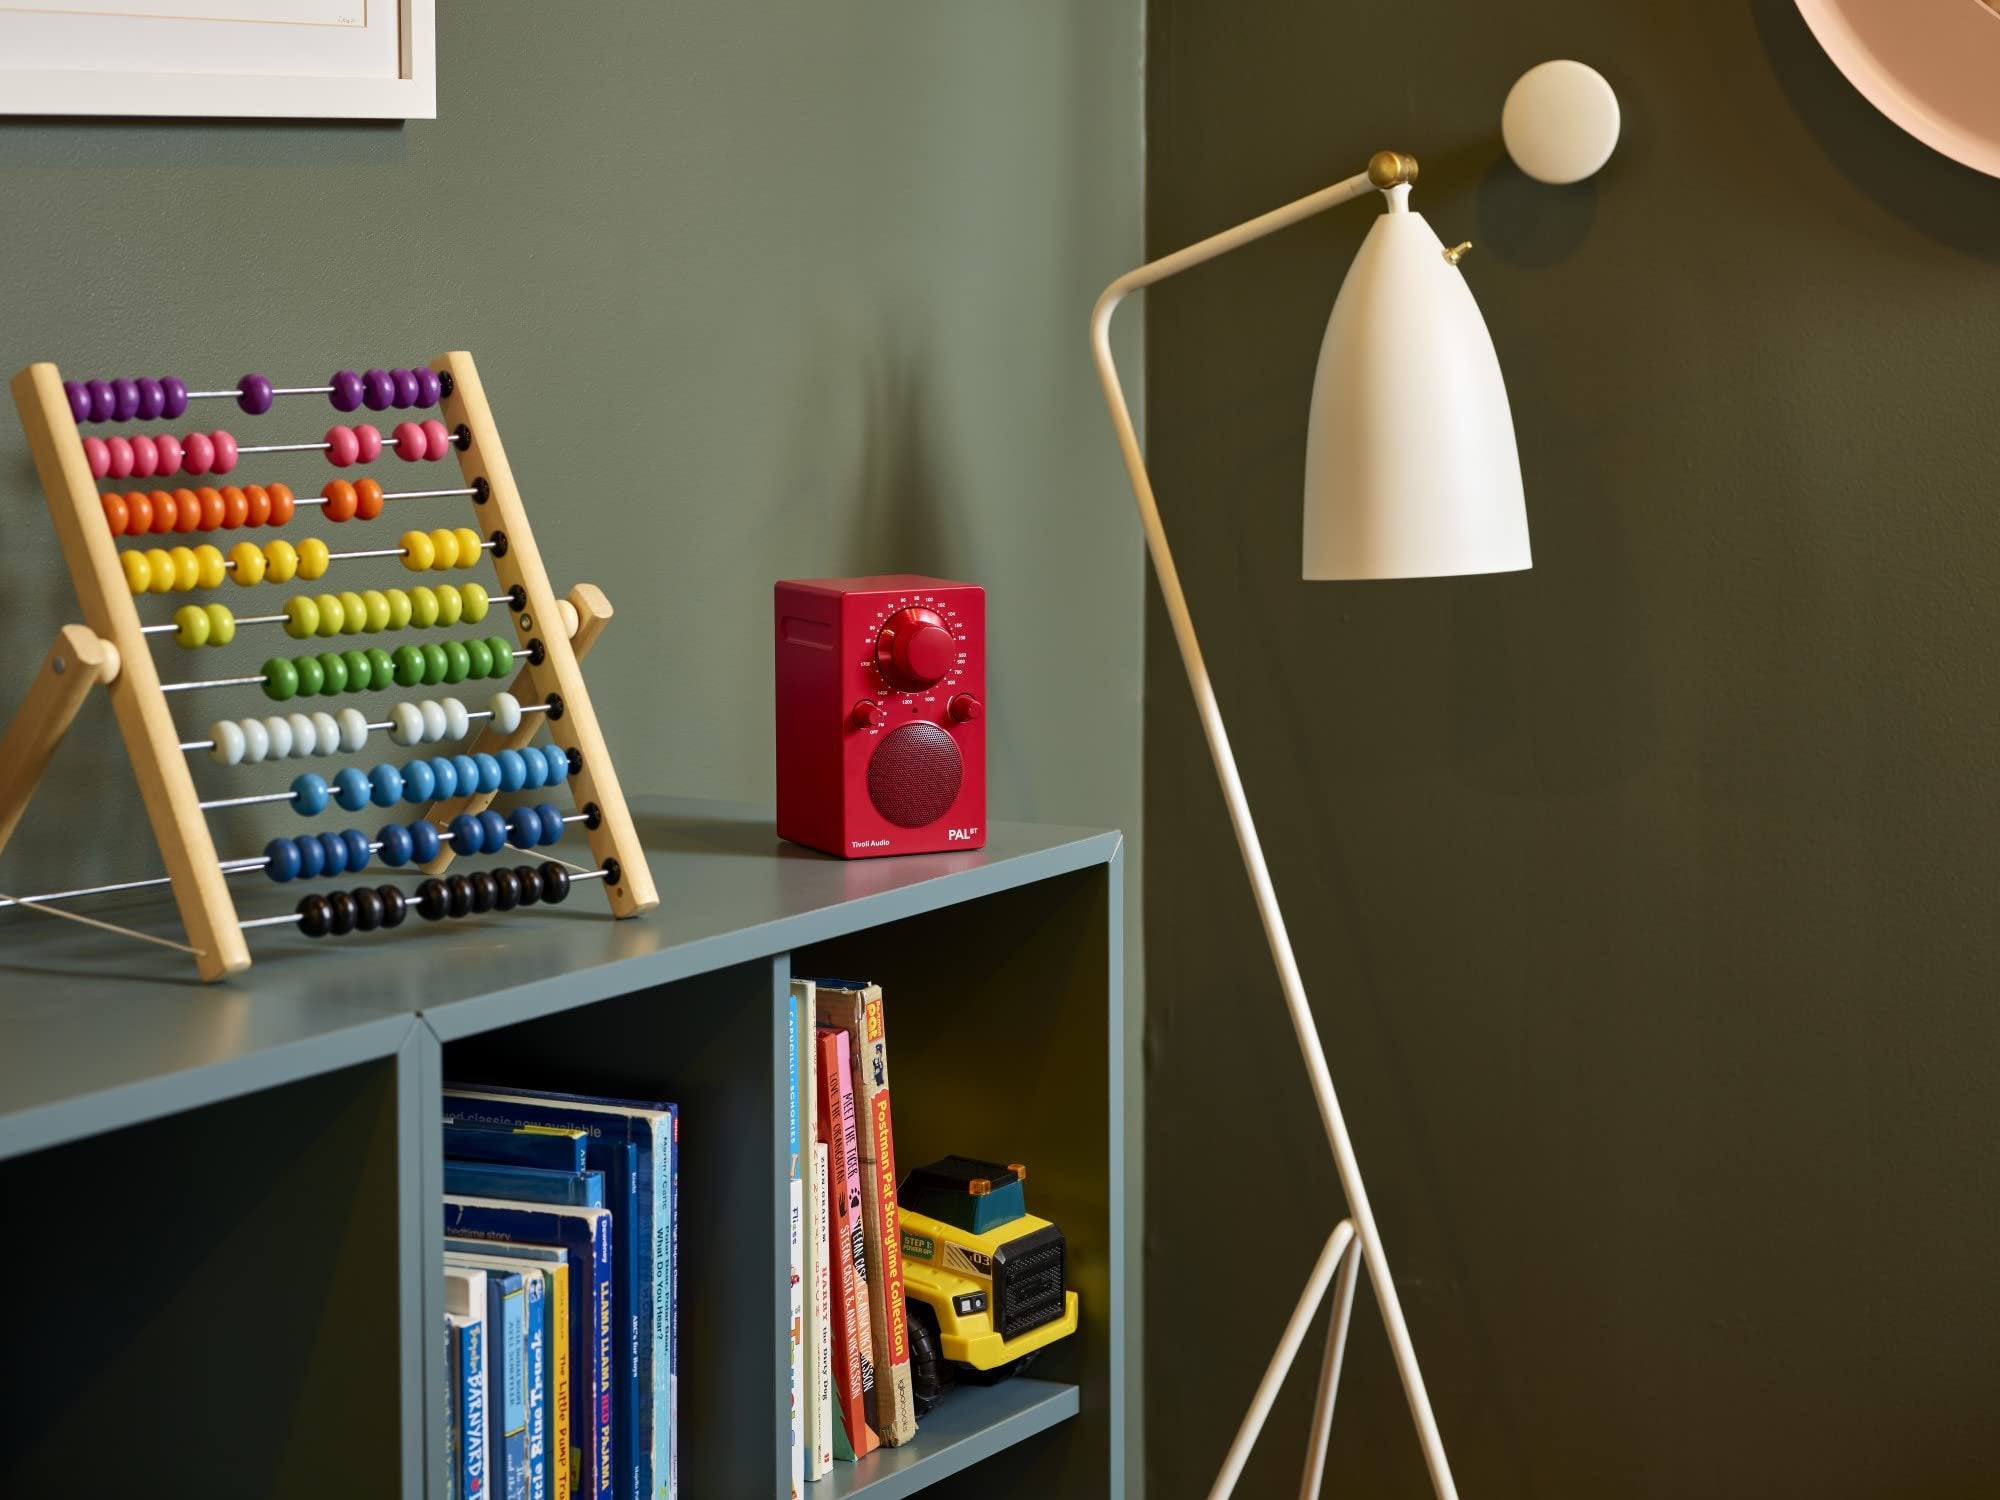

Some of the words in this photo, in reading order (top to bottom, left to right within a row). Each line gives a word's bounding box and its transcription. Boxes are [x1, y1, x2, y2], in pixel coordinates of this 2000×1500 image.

[871, 839, 890, 847] Audio
[948, 829, 971, 840] PAL
[829, 1072, 839, 1097] LOVE
[831, 1101, 841, 1122] THE
[843, 1092, 855, 1121] MEET
[844, 1125, 857, 1146] THE
[877, 1100, 890, 1171] Postman
[833, 1123, 846, 1185] ORANGUTAN
[846, 1147, 859, 1179] TIGER
[882, 1171, 894, 1200] Pat
[840, 1224, 852, 1264] STEFAN
[884, 1201, 898, 1278] Storytime
[903, 1245, 923, 1253] POWER
[904, 1237, 925, 1249] STEP
[657, 1262, 663, 1277] Do
[842, 1264, 854, 1296] CASTA
[601, 1281, 609, 1336] LLAMA
[845, 1296, 854, 1308] &
[846, 1308, 857, 1337] ANNA
[890, 1280, 904, 1357] Collection
[530, 1329, 543, 1408] Truck
[559, 1353, 567, 1375] The
[601, 1337, 609, 1392] LLAMA
[848, 1335, 861, 1400] VIKTORSSON
[558, 1381, 567, 1421] Little
[601, 1393, 609, 1424] RED
[467, 1372, 483, 1476] BARNYARD
[530, 1407, 544, 1459] Blue
[601, 1425, 609, 1491] PAJAMA
